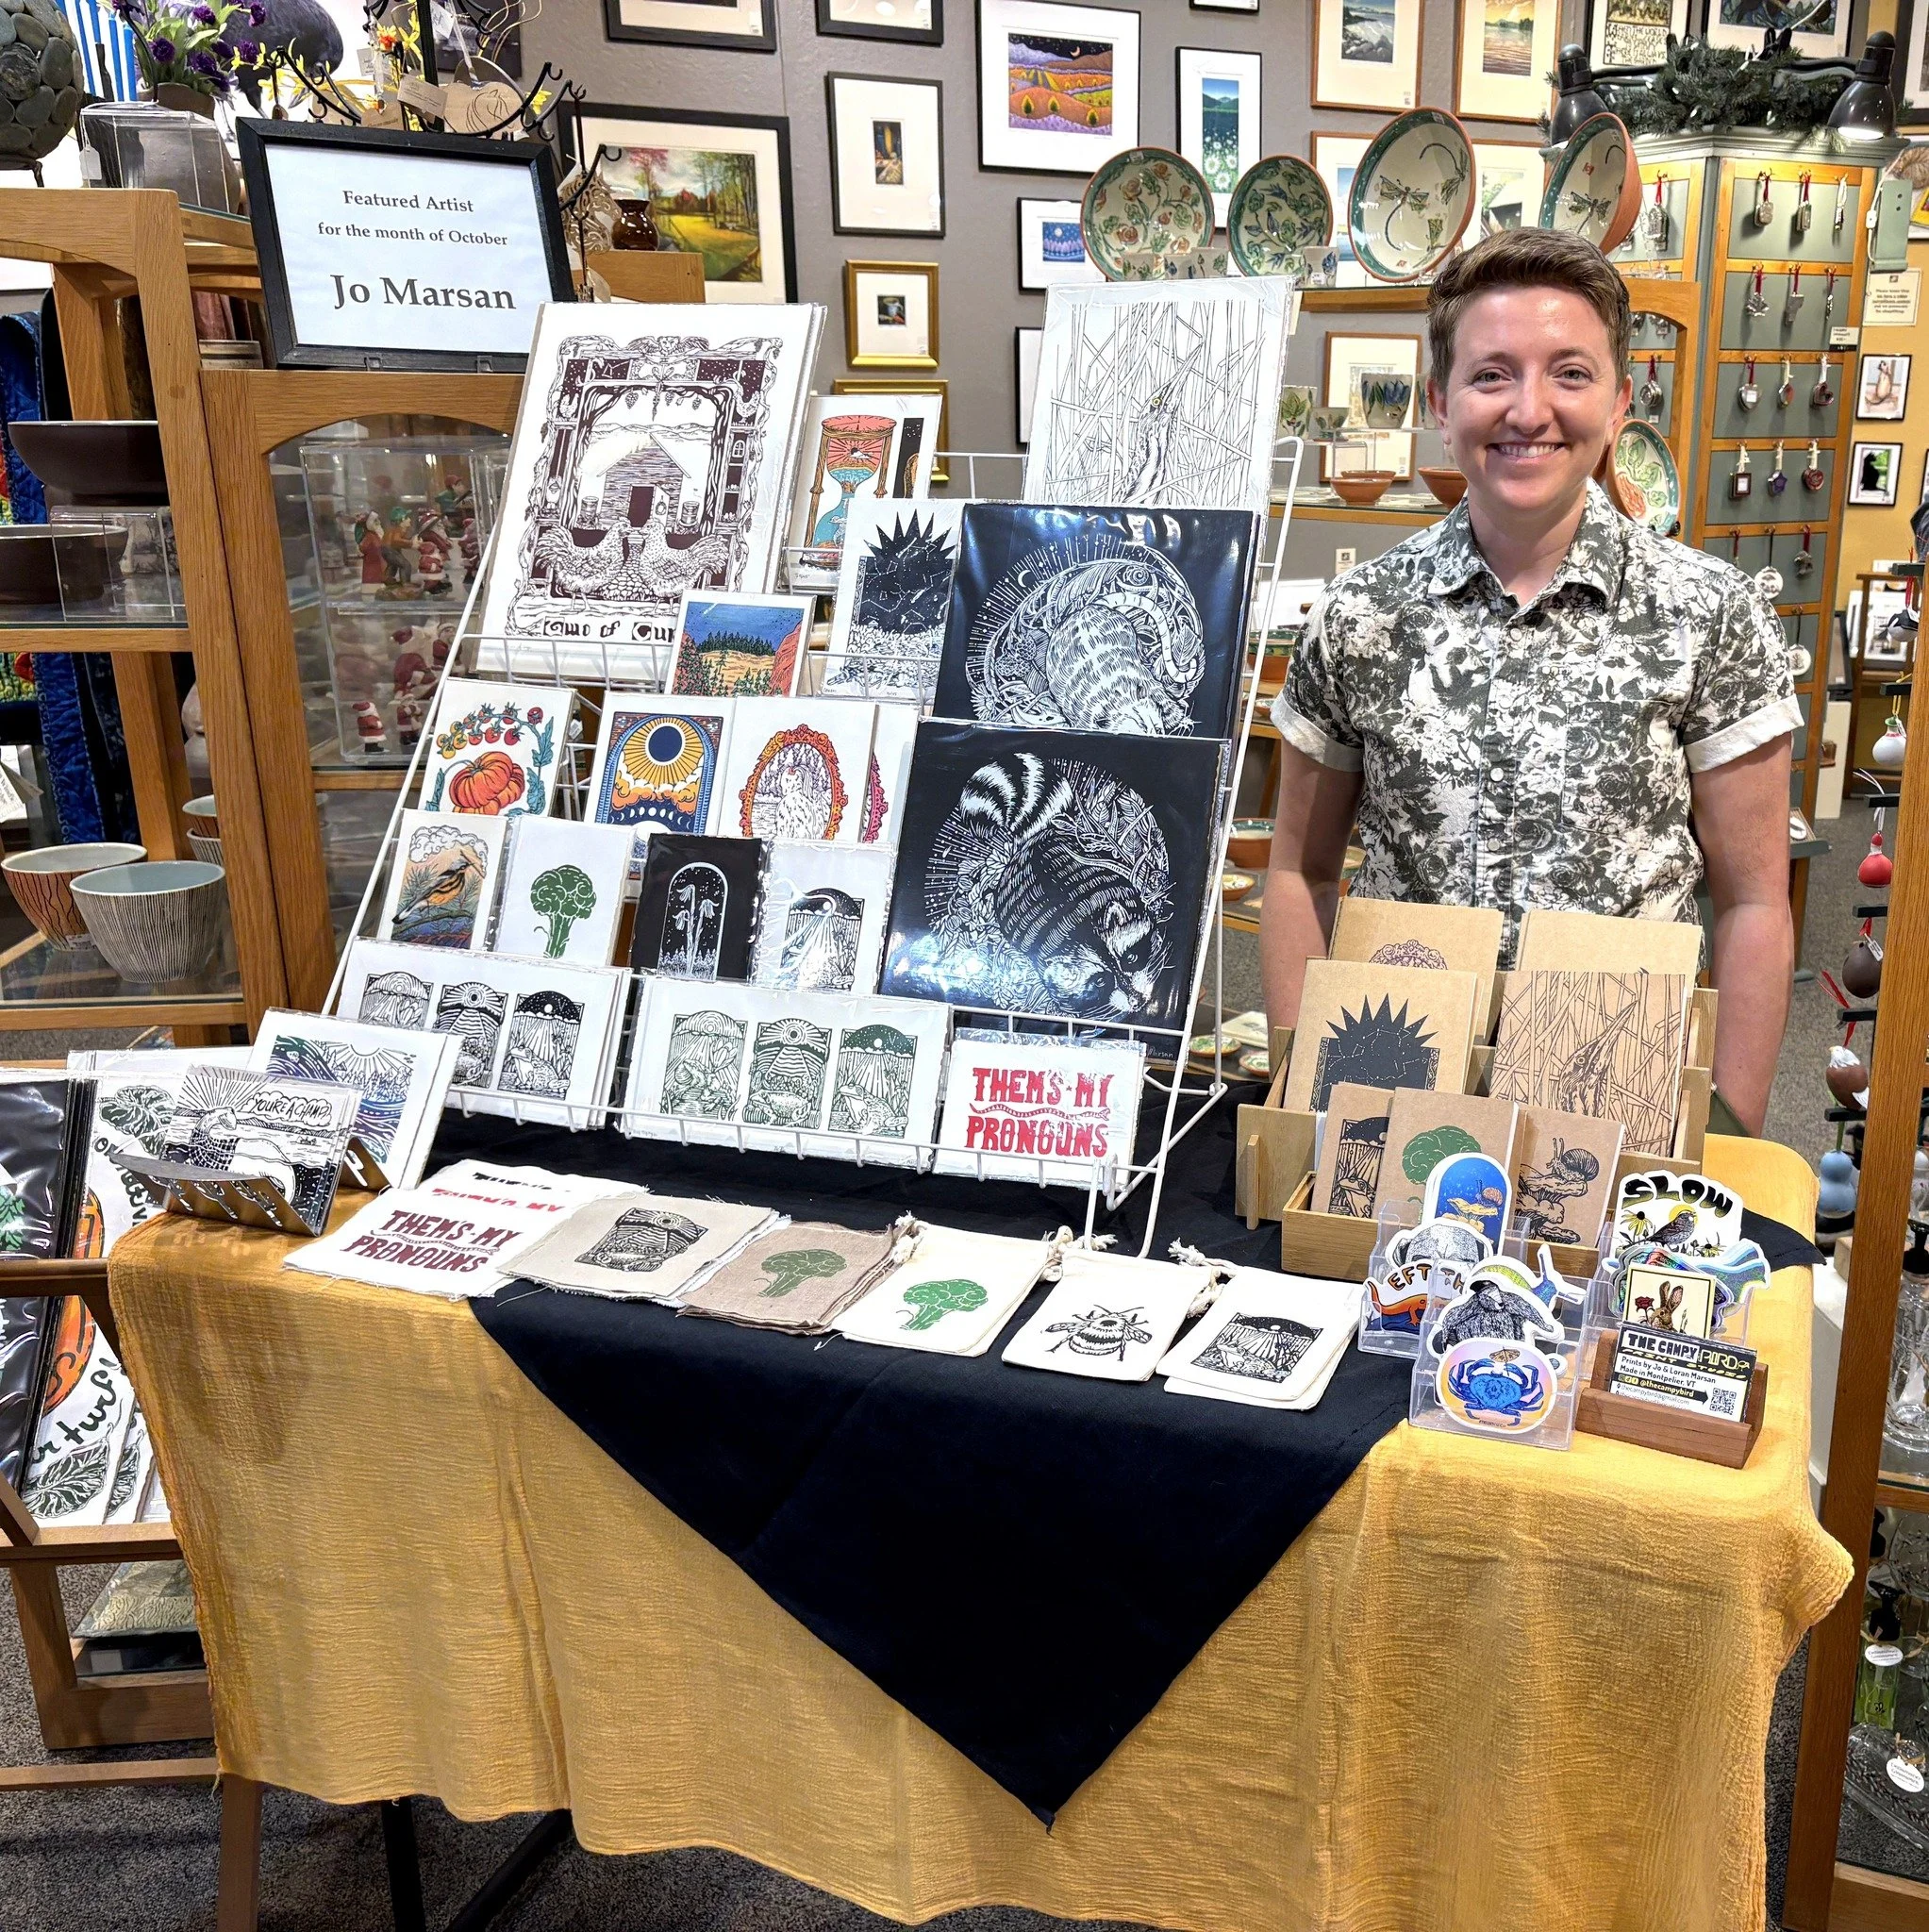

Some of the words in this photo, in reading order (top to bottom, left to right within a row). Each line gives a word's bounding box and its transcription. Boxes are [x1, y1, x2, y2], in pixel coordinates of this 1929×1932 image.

[342, 190, 420, 208] Featured
[425, 196, 474, 212] Artist
[318, 223, 341, 235] for
[345, 224, 371, 238] the
[375, 227, 425, 241] month
[429, 229, 444, 242] of
[448, 230, 507, 245] October
[330, 275, 371, 309] Jo
[379, 276, 517, 309] Marsan
[600, 620, 621, 639] of
[286, 1101, 295, 1120] A
[964, 1115, 1109, 1158] PRONOUNS
[1621, 1174, 1734, 1219] SLOW
[472, 1226, 524, 1248] MY
[340, 1234, 490, 1274] PRONOUNS
[1388, 1262, 1433, 1291] EFT
[1628, 1333, 1656, 1353] THE
[1657, 1340, 1699, 1360] CAMPY
[1698, 1349, 1739, 1370] BIRD
[1620, 1364, 1638, 1375] Made
[1638, 1368, 1646, 1376] in
[1686, 1379, 1697, 1388] VT
[1621, 1356, 1642, 1368] Prints
[1643, 1360, 1653, 1371] by
[1653, 1362, 1662, 1372] Jo
[1669, 1366, 1690, 1378] Loran
[1690, 1371, 1716, 1384] Marsan
[1639, 1377, 1694, 1397] @thecampybird
